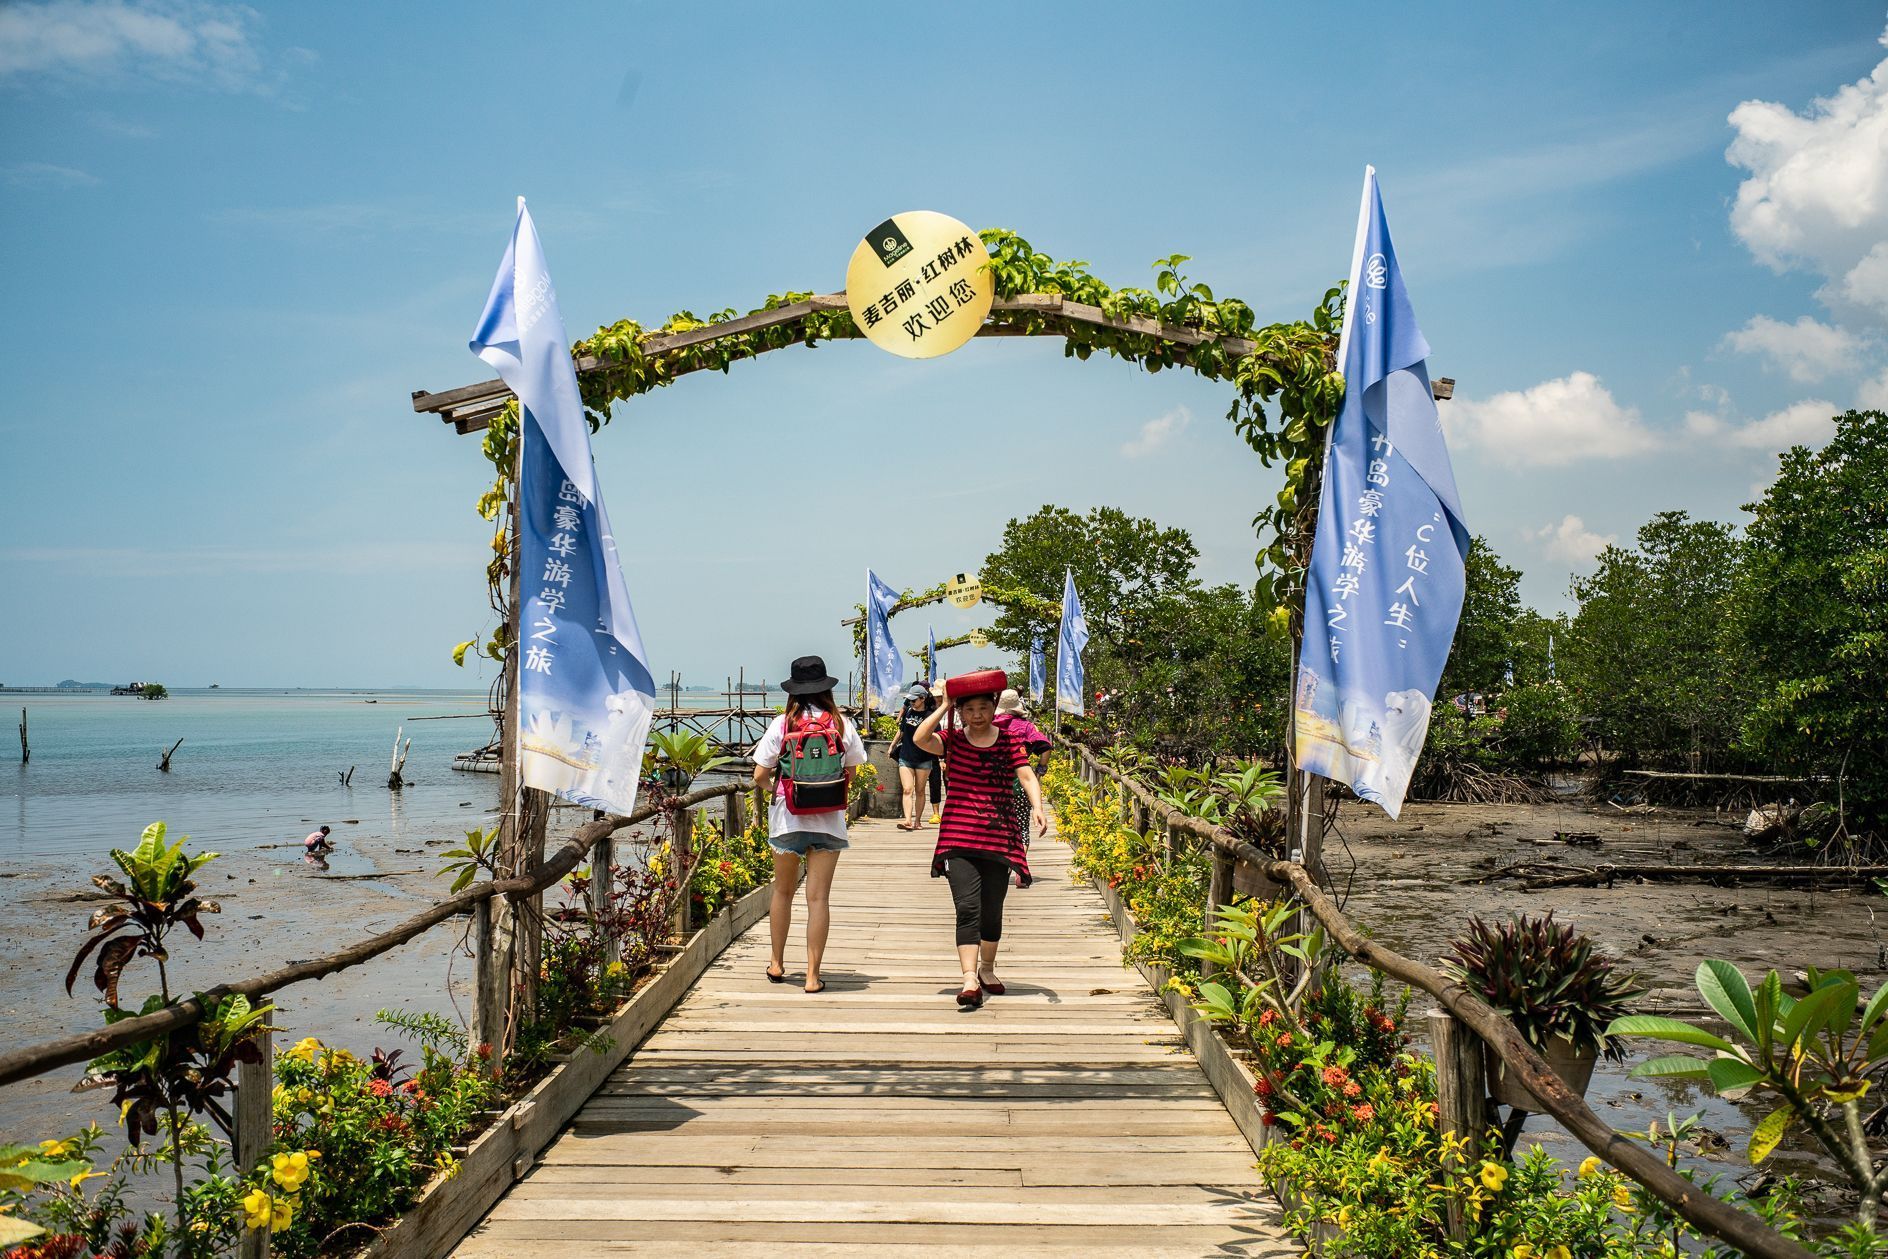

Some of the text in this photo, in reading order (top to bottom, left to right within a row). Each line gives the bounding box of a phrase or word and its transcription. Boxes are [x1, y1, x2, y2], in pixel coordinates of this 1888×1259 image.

[862, 236, 975, 329] 麦吉丽·红树林
[902, 278, 977, 342] 欢迎您
